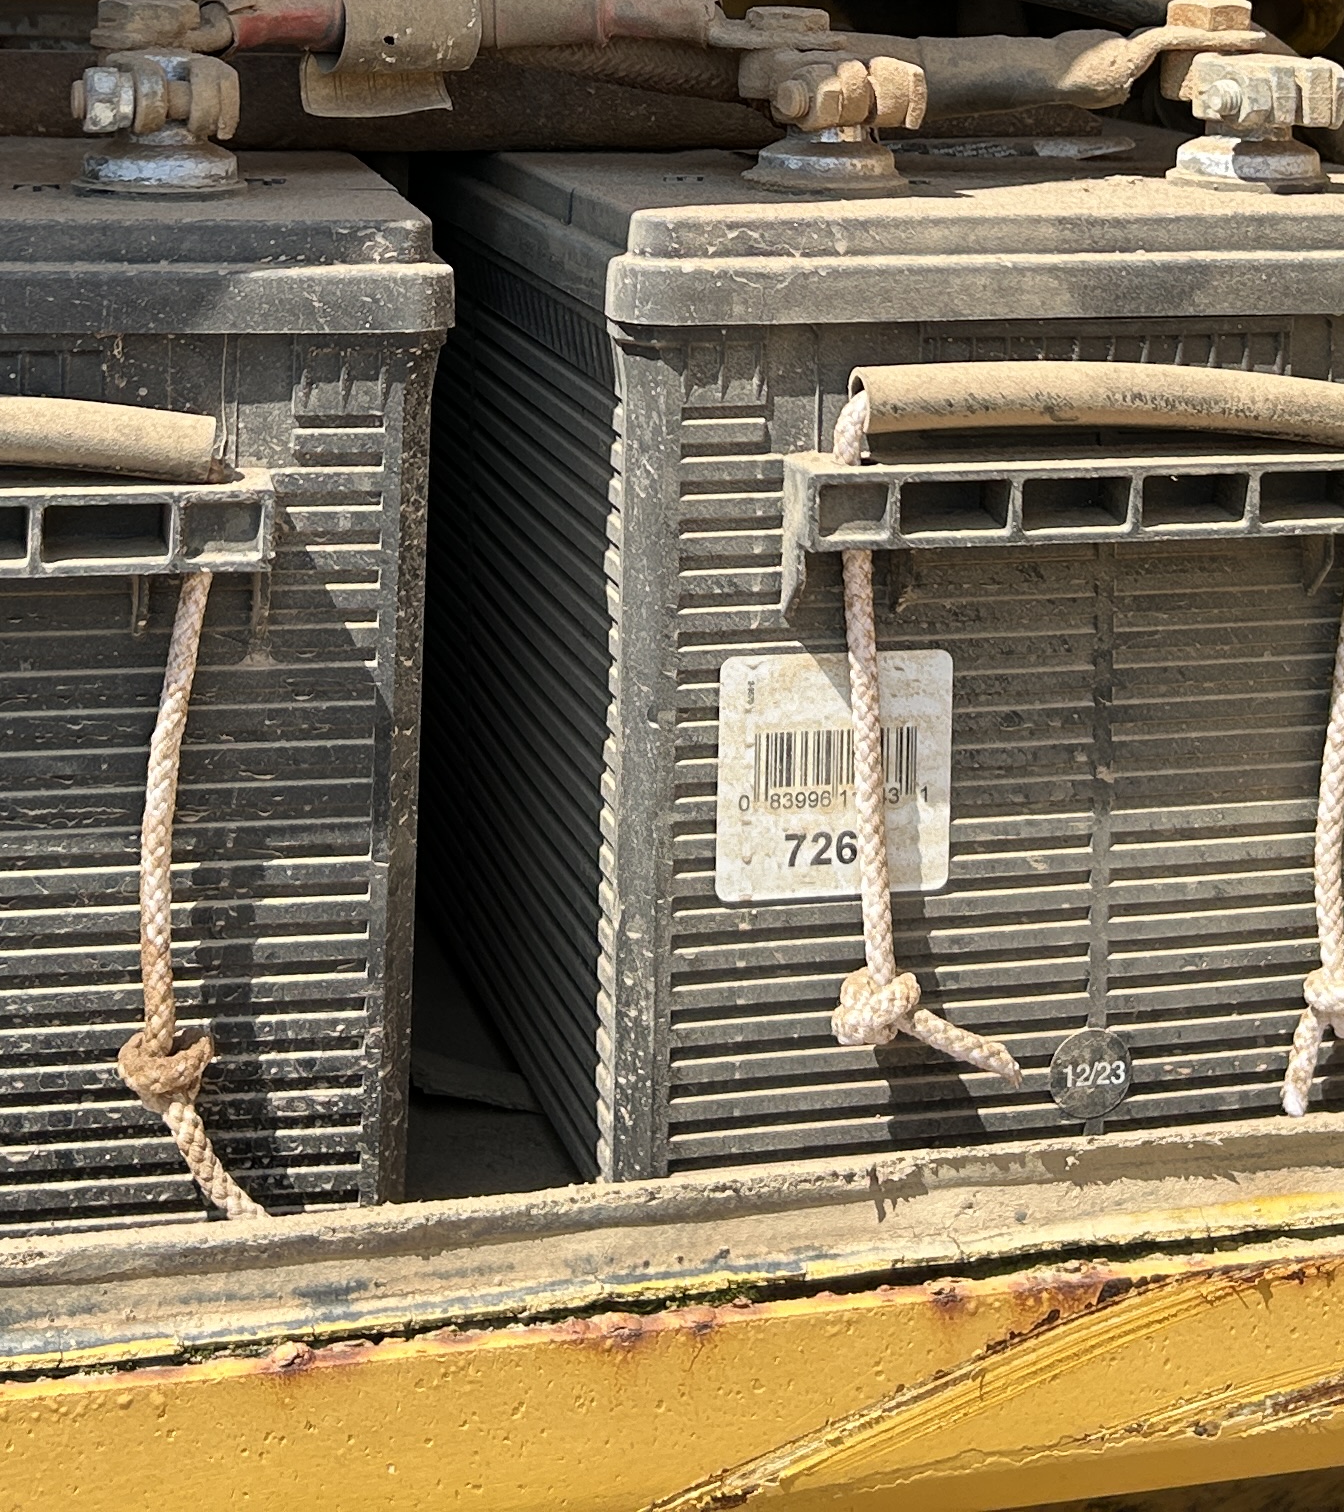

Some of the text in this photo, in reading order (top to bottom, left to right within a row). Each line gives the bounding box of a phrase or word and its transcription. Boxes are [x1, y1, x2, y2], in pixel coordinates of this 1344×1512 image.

[738, 795, 750, 812] 0
[770, 790, 832, 809] 83996
[921, 786, 929, 804] 1
[784, 830, 859, 867] 726
[1062, 1060, 1126, 1088] 12/23
